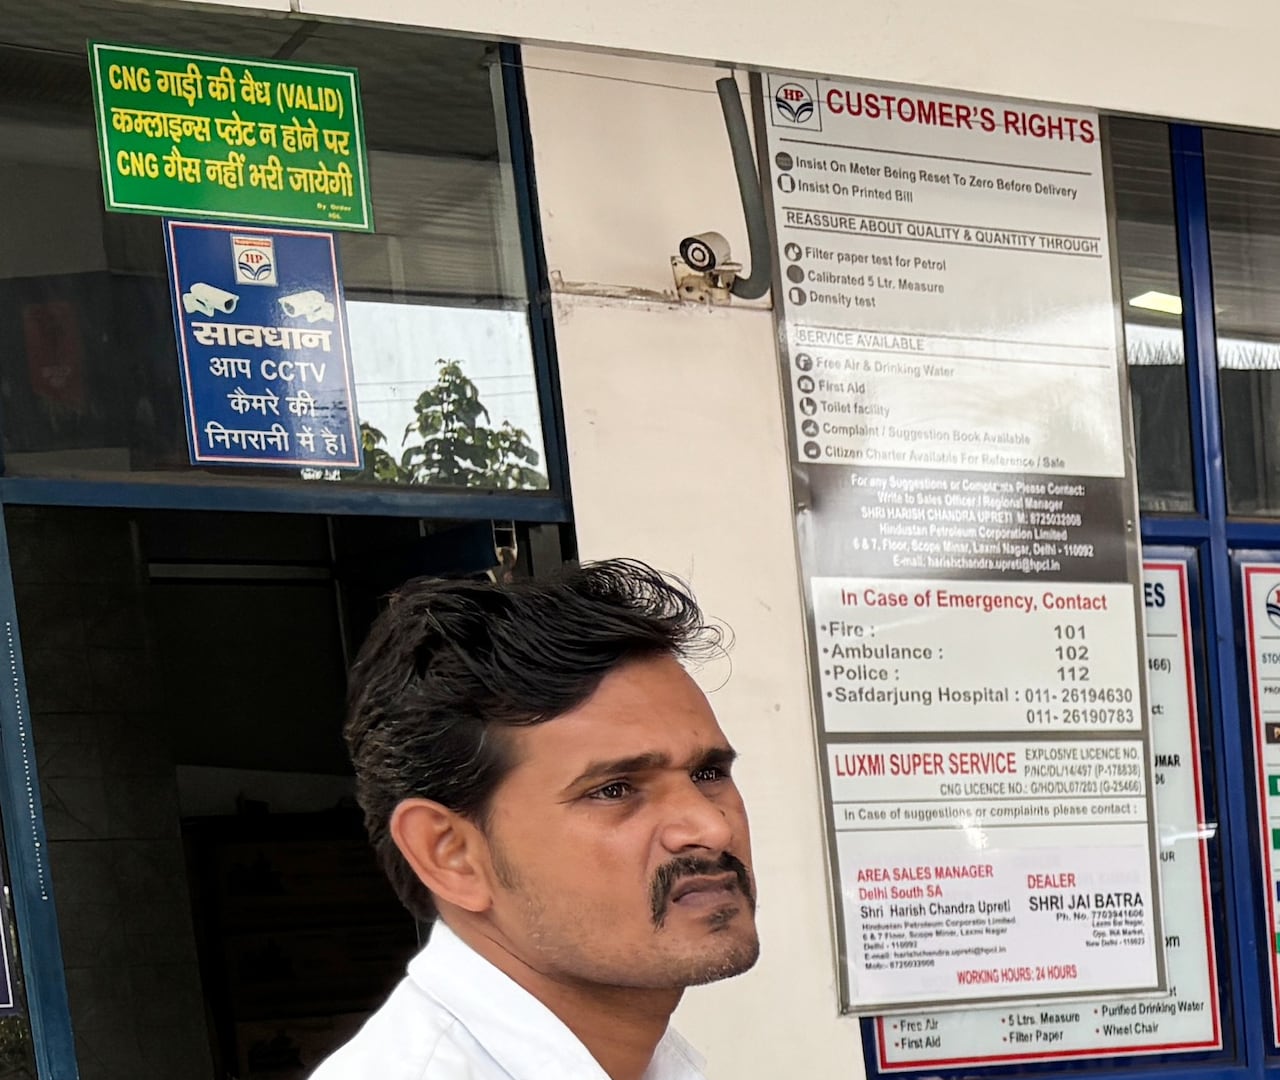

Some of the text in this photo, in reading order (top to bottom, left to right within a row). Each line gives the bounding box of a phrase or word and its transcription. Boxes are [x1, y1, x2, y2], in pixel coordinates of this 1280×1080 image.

[108, 62, 344, 120] CNG गाड़ी की वैध (VALID)
[783, 88, 804, 101] HP
[215, 110, 256, 147] प्लेट
[259, 122, 277, 148] न
[280, 116, 319, 153] होने
[322, 129, 350, 156] पर
[1003, 110, 1095, 144] RIGHTS
[116, 145, 354, 197] CNG गैस नहीं भरी जायेगी
[796, 156, 1078, 200] Insist On Meter Being Reset To Zero Before Delivery
[786, 211, 1099, 253] REASSURE ABOUT QUALITY & QUANTITY THROUGH
[244, 253, 263, 264] HP
[191, 321, 333, 352] सावधान
[209, 357, 327, 383] आप CCTV
[227, 386, 317, 417] कैमरे की
[204, 420, 290, 452] निगरानी
[296, 425, 315, 453] में
[841, 589, 1108, 613] In Case of Emergency, Contact
[830, 622, 1087, 641] Fire 101
[831, 643, 1090, 662] Ambulance 102
[833, 665, 1091, 683] Police 112
[835, 687, 933, 706] Safdarjung
[938, 687, 1010, 706] Hospital
[1062, 687, 1133, 704] 26194630
[1062, 708, 1135, 725] 26190783
[835, 752, 1017, 777] LUXMI SUPER SERVICE
[857, 864, 994, 883] AREA SALES MANAGER
[1027, 873, 1076, 889] DEALER
[1029, 892, 1144, 912] SHRI JAI BATRA
[957, 964, 1078, 985] WORKING HOURS: 24 HOURS
